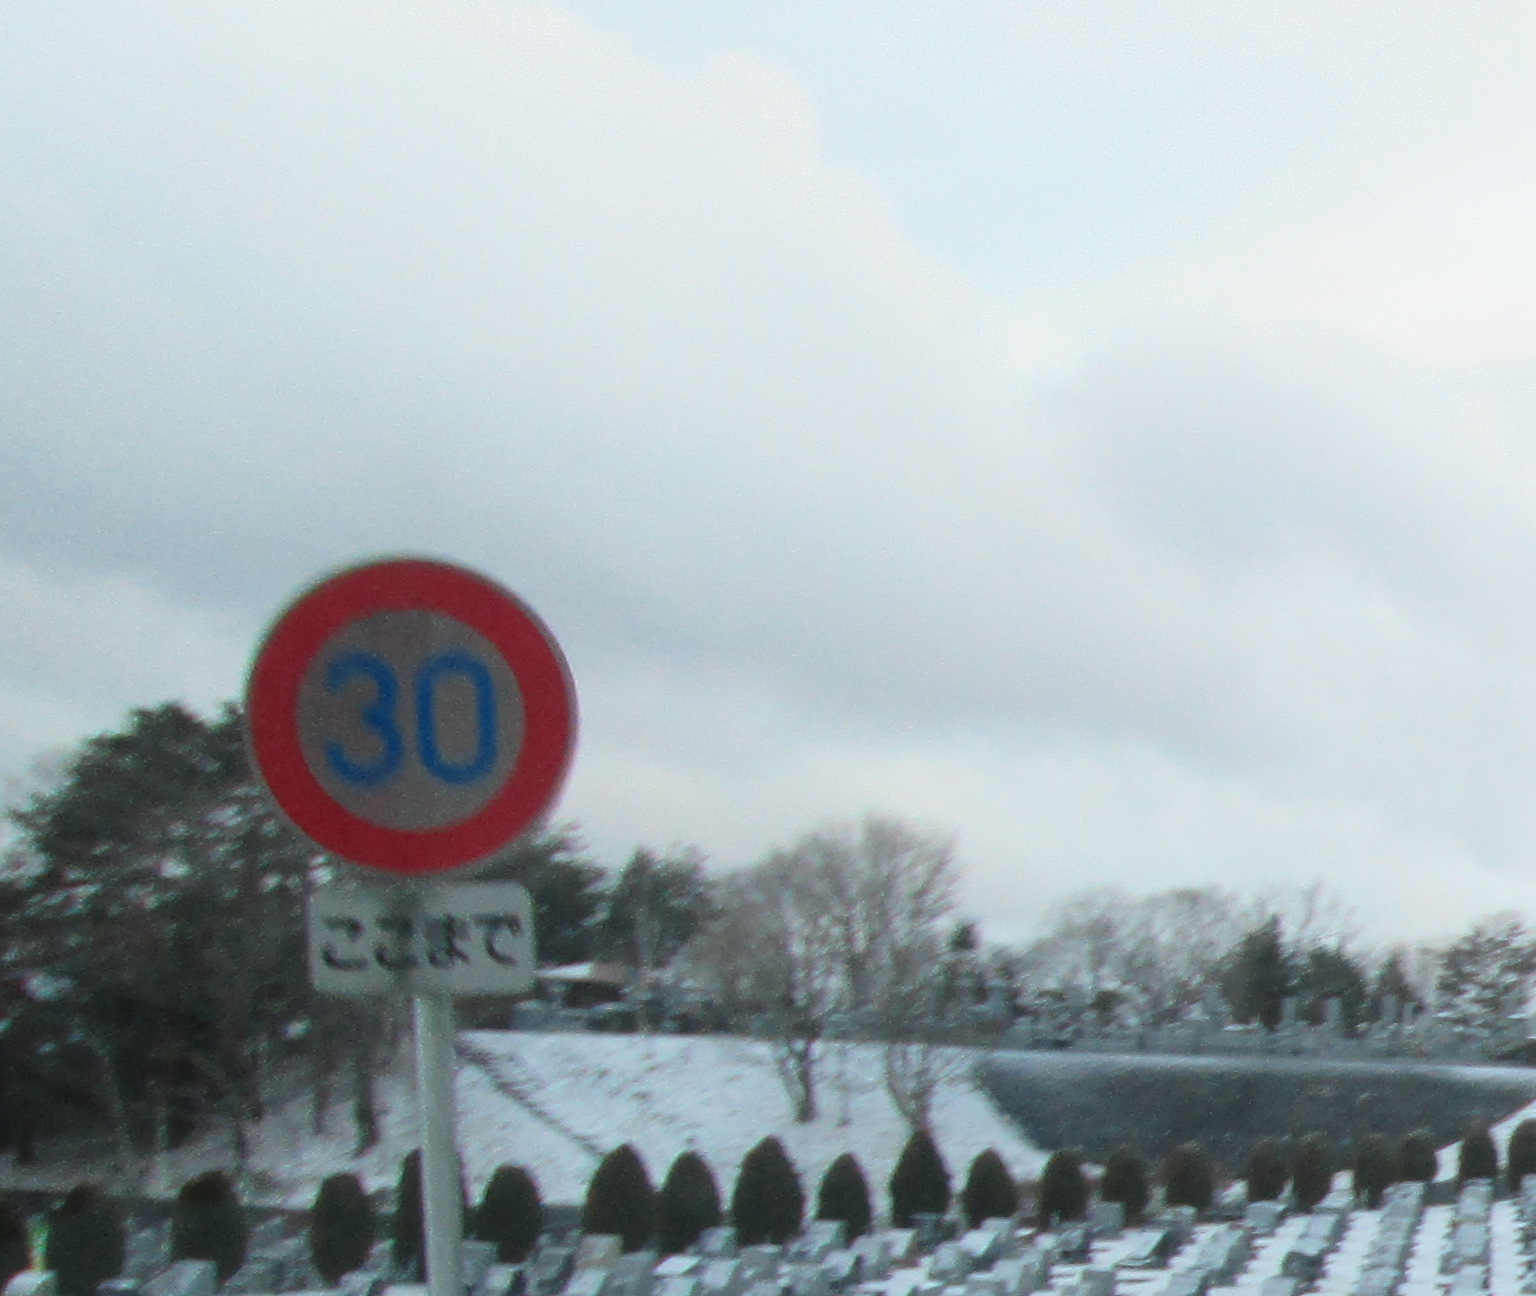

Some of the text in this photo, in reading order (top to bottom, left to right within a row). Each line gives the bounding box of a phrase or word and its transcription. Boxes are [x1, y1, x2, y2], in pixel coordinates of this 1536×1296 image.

[322, 649, 497, 787] 30
[321, 912, 524, 972] ここまで
